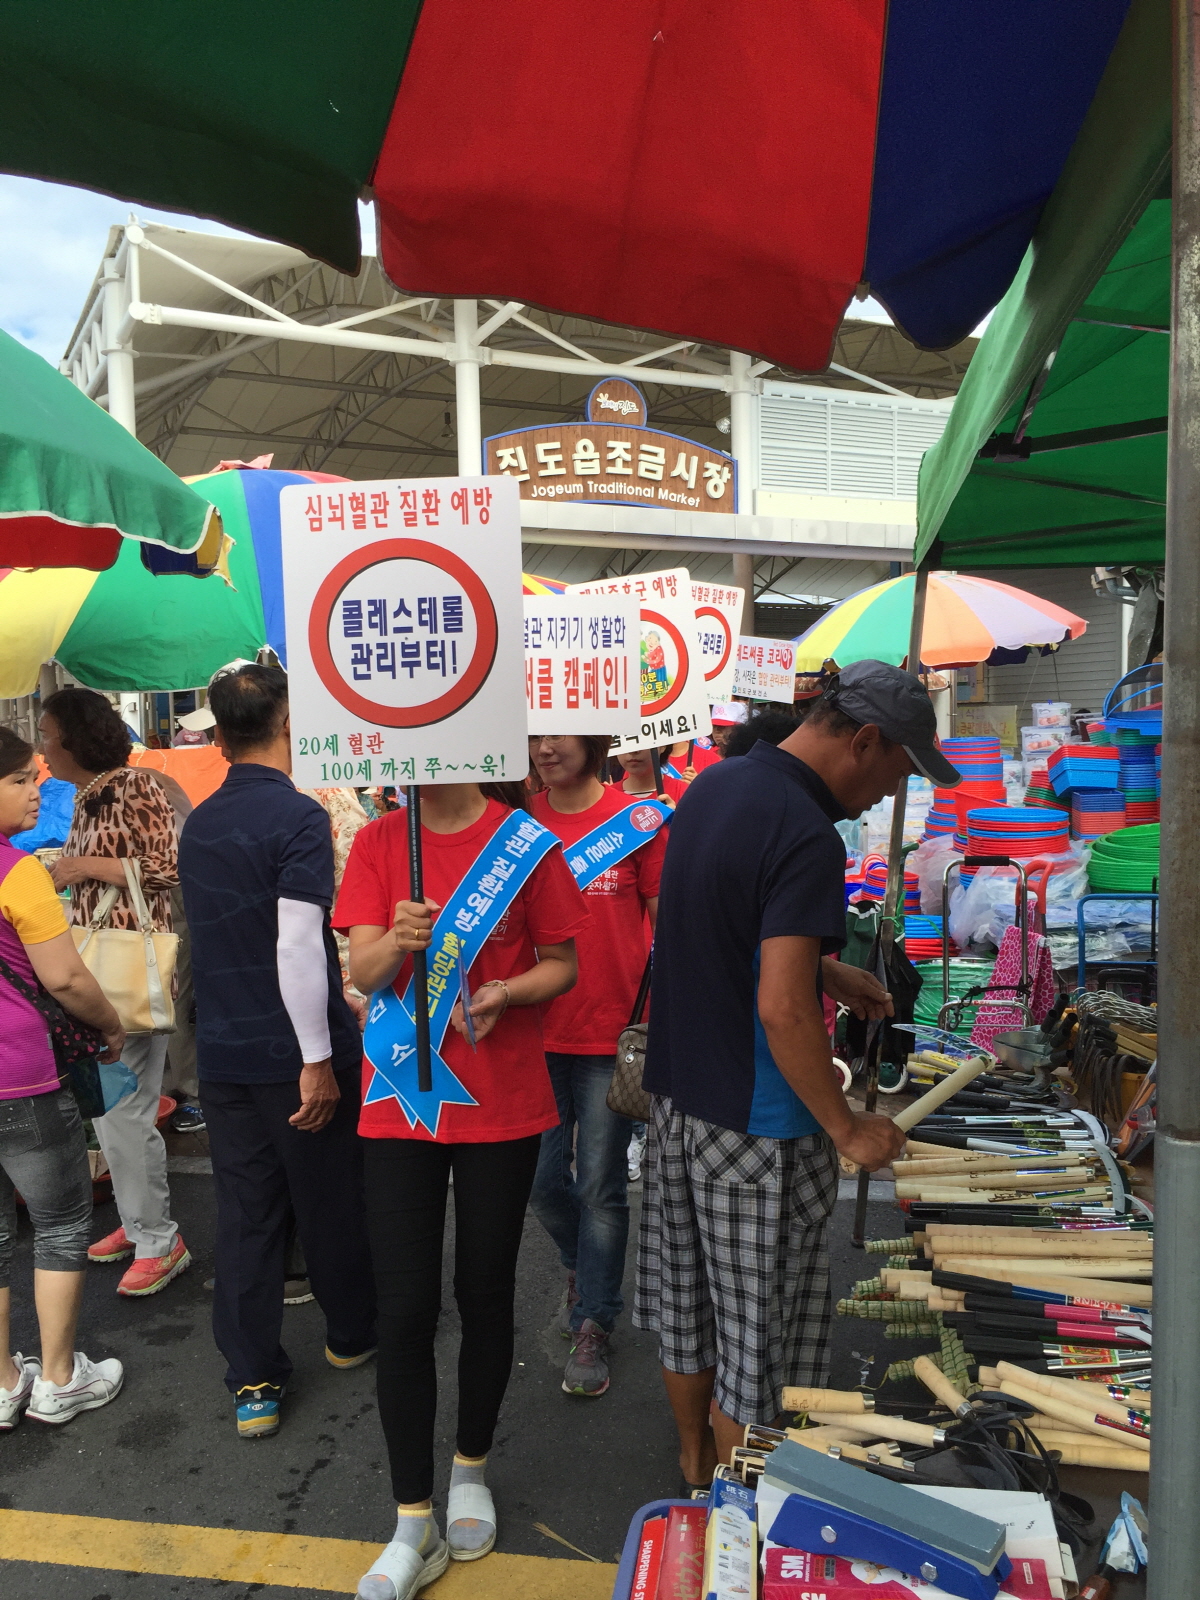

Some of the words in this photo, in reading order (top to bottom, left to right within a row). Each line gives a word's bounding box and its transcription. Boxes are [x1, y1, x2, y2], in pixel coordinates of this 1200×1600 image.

[496, 438, 731, 499] 진도읍조금시장
[305, 491, 389, 532] 심뇌혈관
[399, 489, 440, 527] 질환
[450, 486, 492, 525] 예방
[531, 484, 583, 498] Jogeum
[587, 481, 654, 498] Traditional
[658, 489, 701, 508] Market
[652, 575, 677, 599] 예방
[712, 588, 724, 604] 질환
[726, 591, 738, 606] 예방
[342, 595, 463, 638] 콜레스테롤
[547, 617, 583, 649] 지키기
[589, 615, 625, 649] 생활화
[351, 640, 457, 681] 관리부터!
[767, 648, 792, 670] 코리아
[564, 656, 627, 709] 캠페인!
[742, 670, 756, 685] 시작은
[299, 734, 339, 756] 20세
[347, 732, 384, 755] 혈관
[321, 759, 372, 782] 100세
[381, 758, 416, 781] 까지
[584, 831, 624, 863] 소금은
[601, 869, 619, 880] 혈관
[636, 1540, 653, 1590] SHARPENING
[674, 1551, 703, 1600] ゼウス
[781, 1555, 804, 1579] SM
